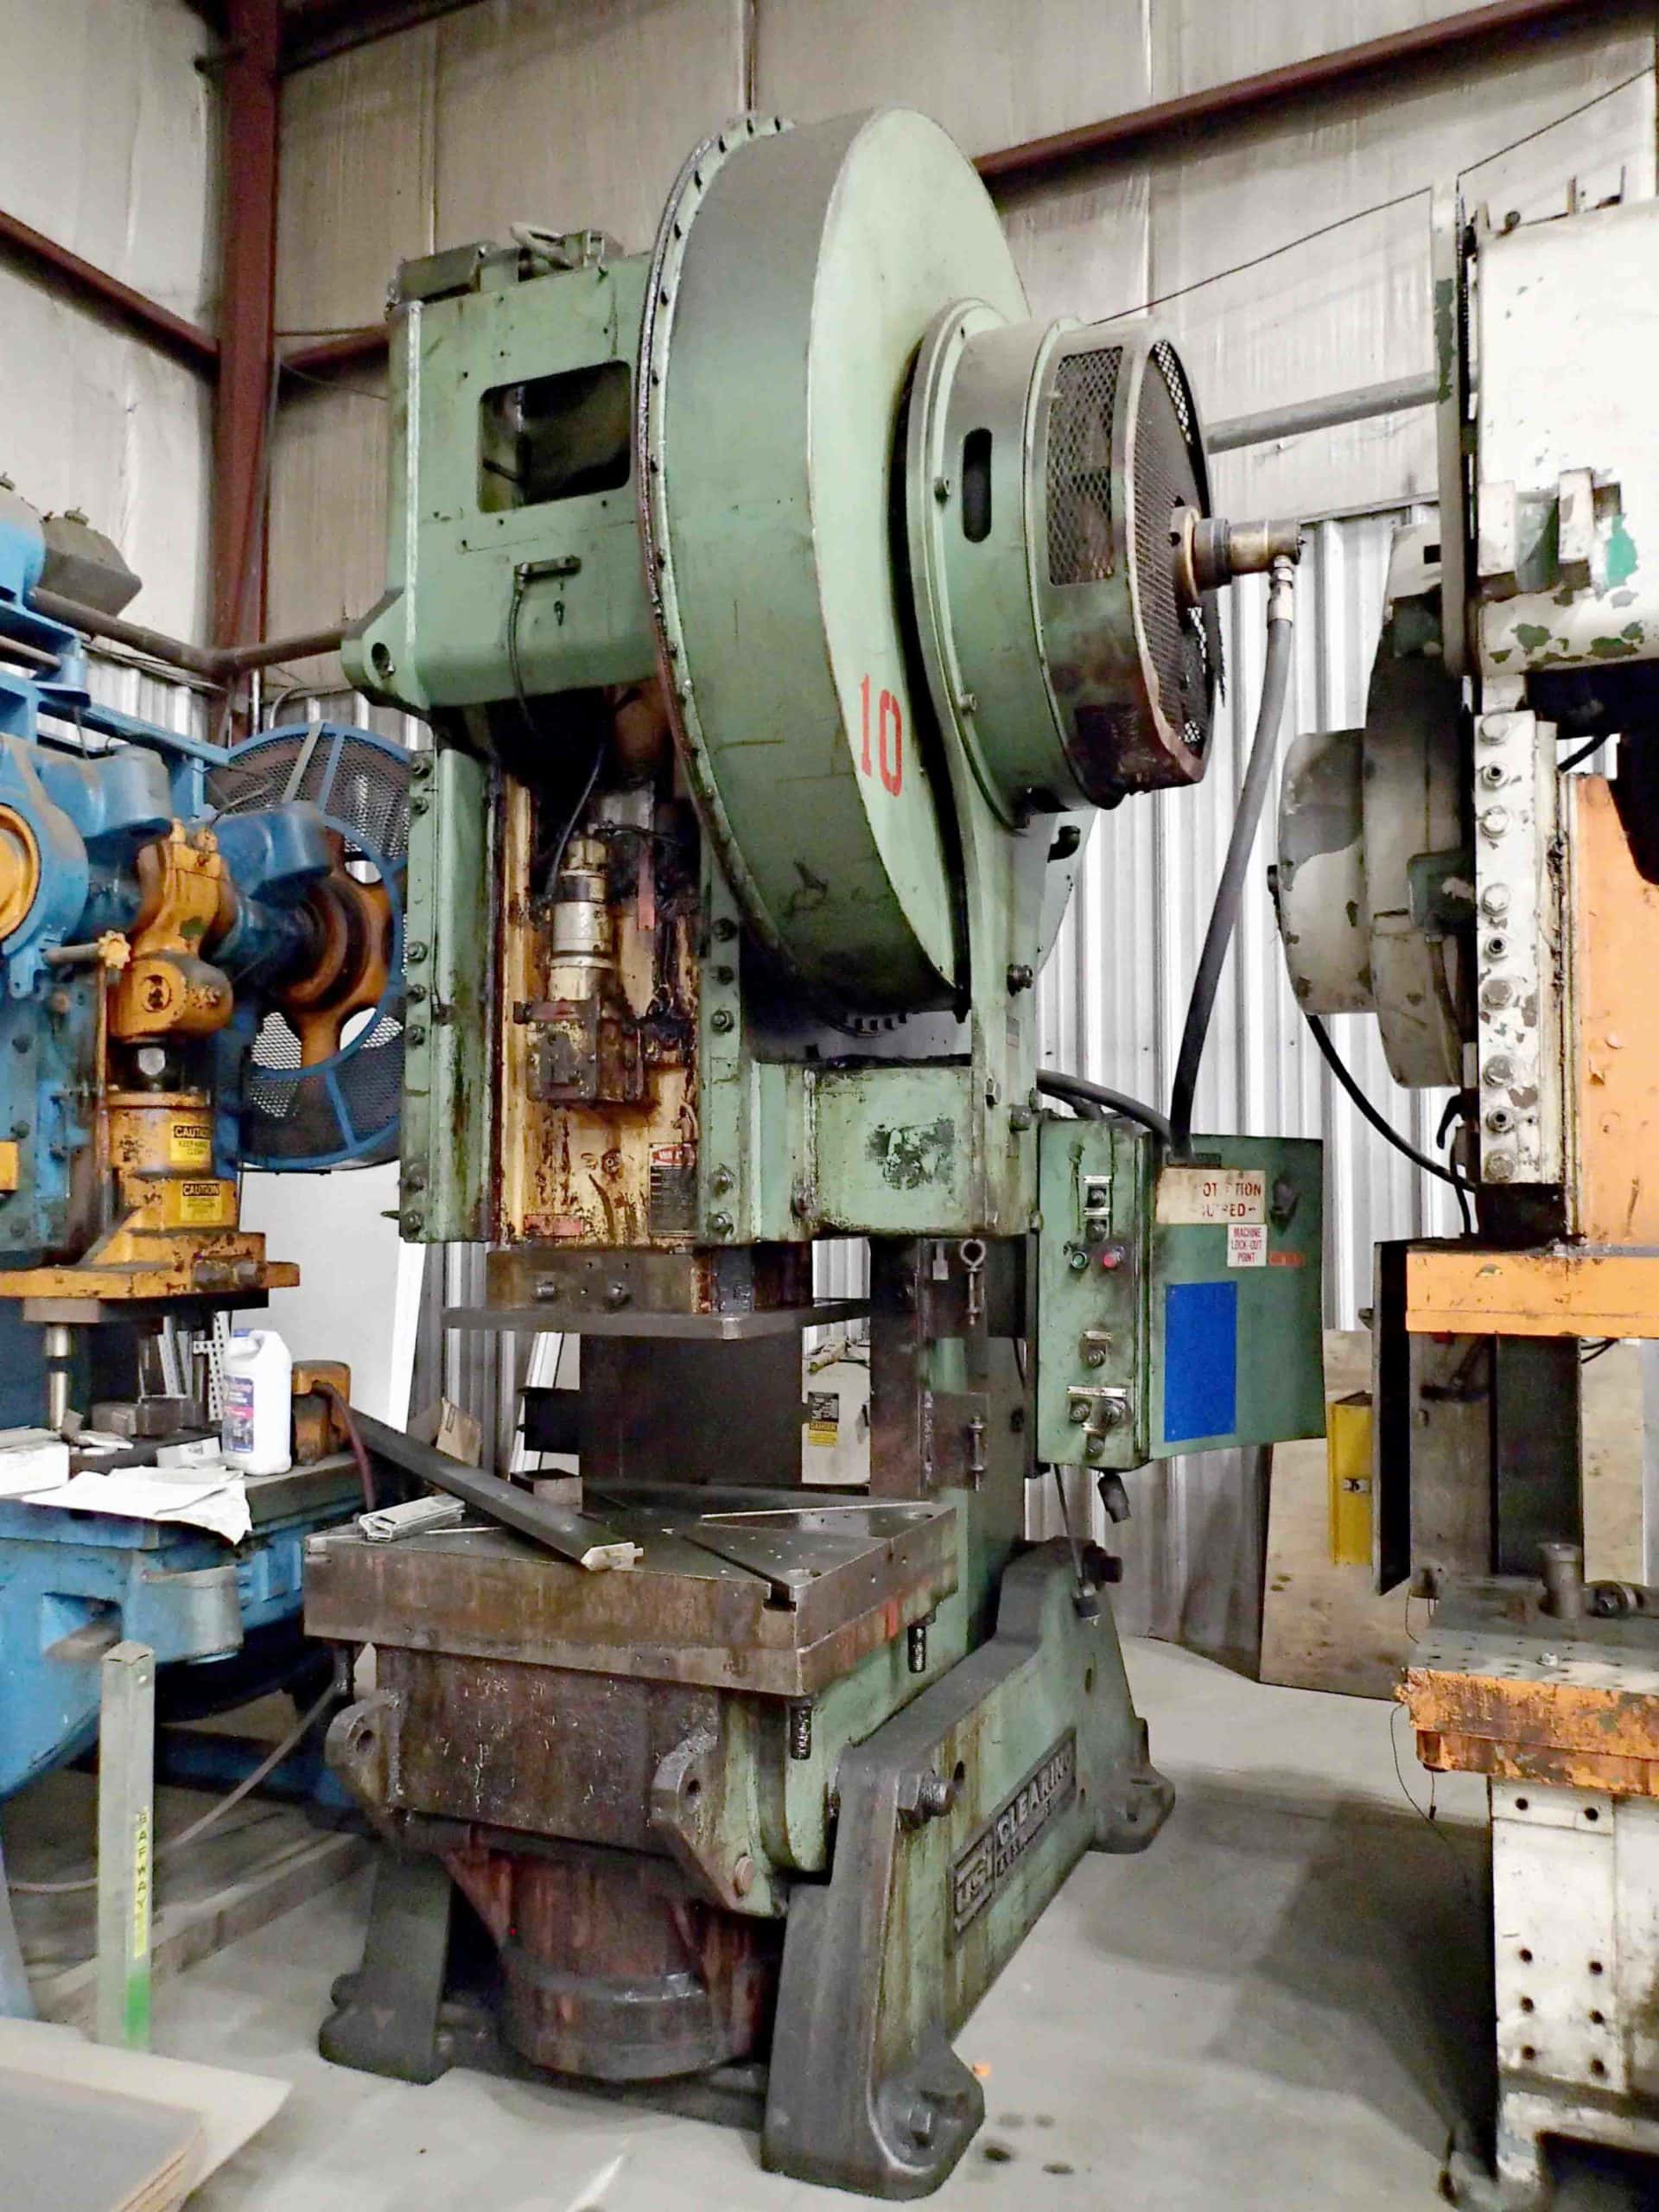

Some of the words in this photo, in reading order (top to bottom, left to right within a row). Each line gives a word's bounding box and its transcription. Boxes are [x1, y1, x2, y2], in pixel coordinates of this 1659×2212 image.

[861, 673, 902, 797] 10
[184, 1185, 219, 1195] CAUTION
[1233, 1227, 1262, 1237] MACHINE
[1237, 1252, 1255, 1262] POINT
